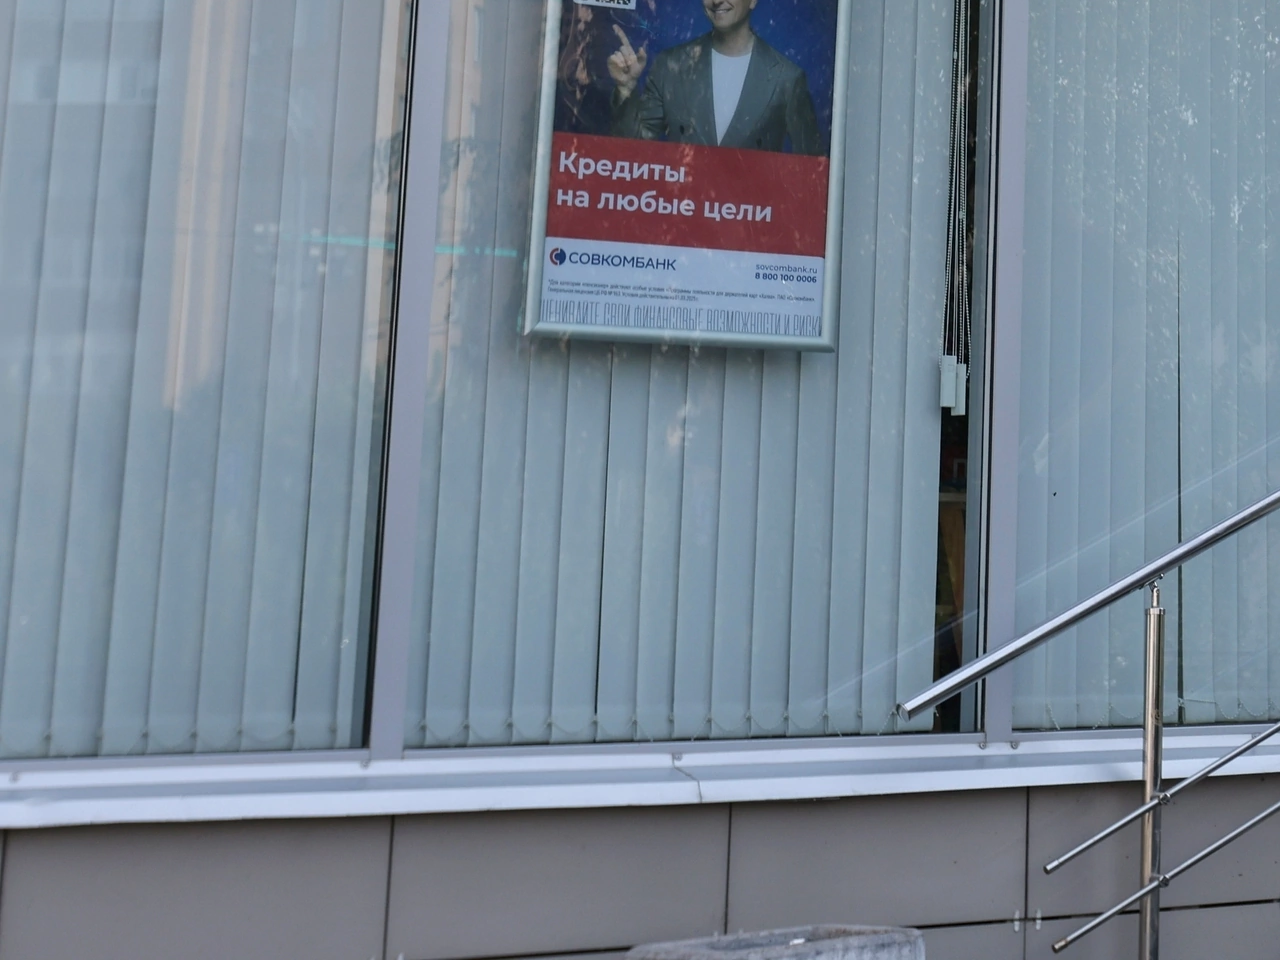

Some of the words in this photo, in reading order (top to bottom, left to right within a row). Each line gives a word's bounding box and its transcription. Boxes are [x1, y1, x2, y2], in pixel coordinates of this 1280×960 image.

[558, 150, 686, 183] Кредиты
[556, 188, 590, 208] на
[597, 190, 696, 217] любые
[703, 200, 773, 223] цели
[568, 251, 678, 271] СОВКОМБАНК
[755, 263, 818, 275] sovcombank.ru
[754, 272, 761, 280] 8
[762, 272, 779, 282] 800
[780, 274, 795, 283] 100
[796, 275, 818, 284] 0006
[541, 299, 600, 324] ЦЕНИВАЙТЕ
[603, 301, 631, 327] СВОИ
[633, 305, 704, 330] ФИНАНСОВЫЕ
[706, 308, 781, 335] ВОЗМОЖНОСТИ
[784, 313, 790, 335] И
